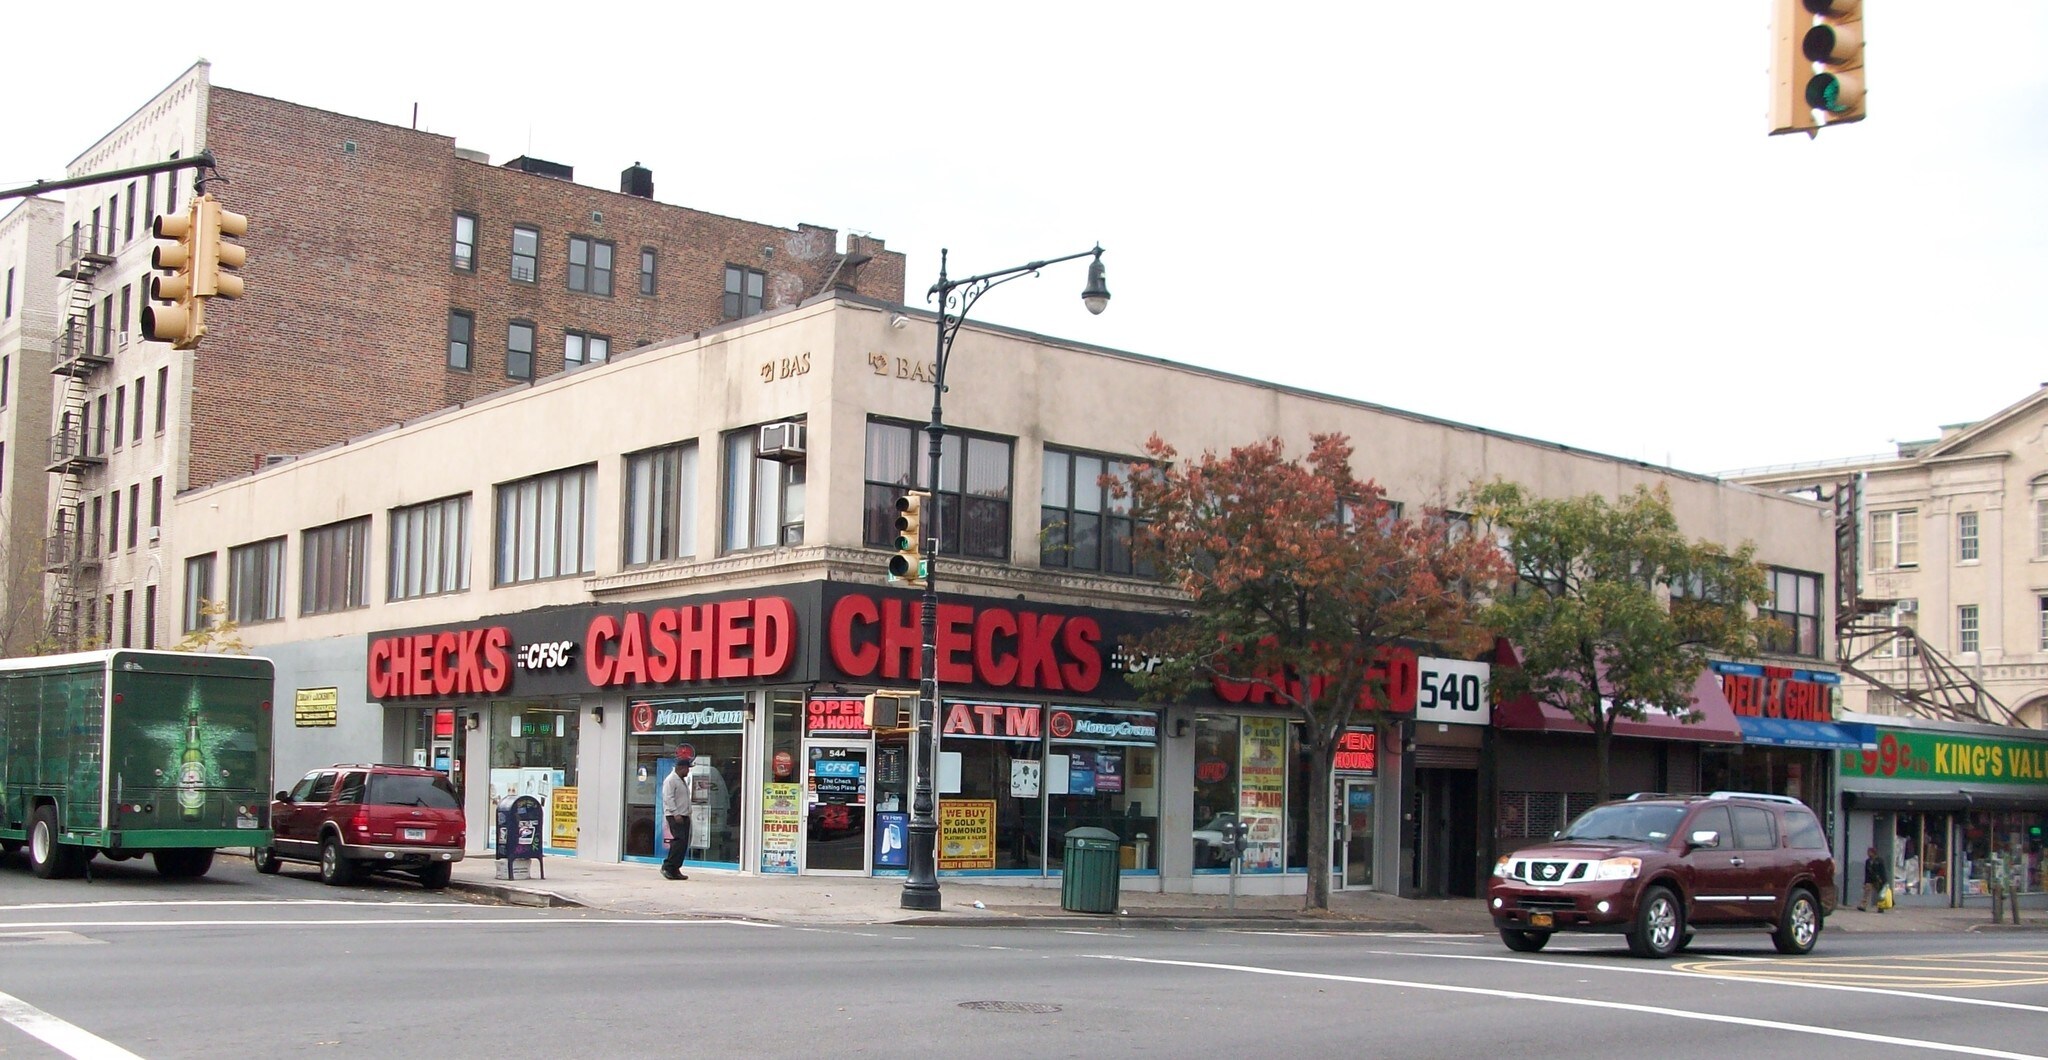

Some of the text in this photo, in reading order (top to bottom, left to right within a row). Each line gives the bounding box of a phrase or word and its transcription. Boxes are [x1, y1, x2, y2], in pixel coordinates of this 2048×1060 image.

[780, 352, 811, 379] BAS
[896, 357, 937, 384] BAS
[369, 597, 797, 698] CHECKS CFSC CASHED
[830, 594, 1102, 692] CHECKS
[1420, 671, 1480, 711] 540
[1725, 674, 1763, 717] DELI
[1768, 678, 1781, 718] &
[1785, 680, 1831, 722] GRILL
[656, 707, 743, 729] MoneyGram
[809, 715, 825, 729] 24
[943, 704, 1040, 738] ATM
[1075, 719, 1156, 737] MoneyGram
[1337, 732, 1375, 751] PEN
[829, 749, 846, 757] 544
[1335, 752, 1375, 769] HOURS
[1935, 743, 2003, 776] KING'S
[2008, 747, 2048, 778] VAL
[825, 762, 855, 773] CFSC
[946, 809, 986, 817] WE BUY
[764, 824, 799, 832] REPAIR
